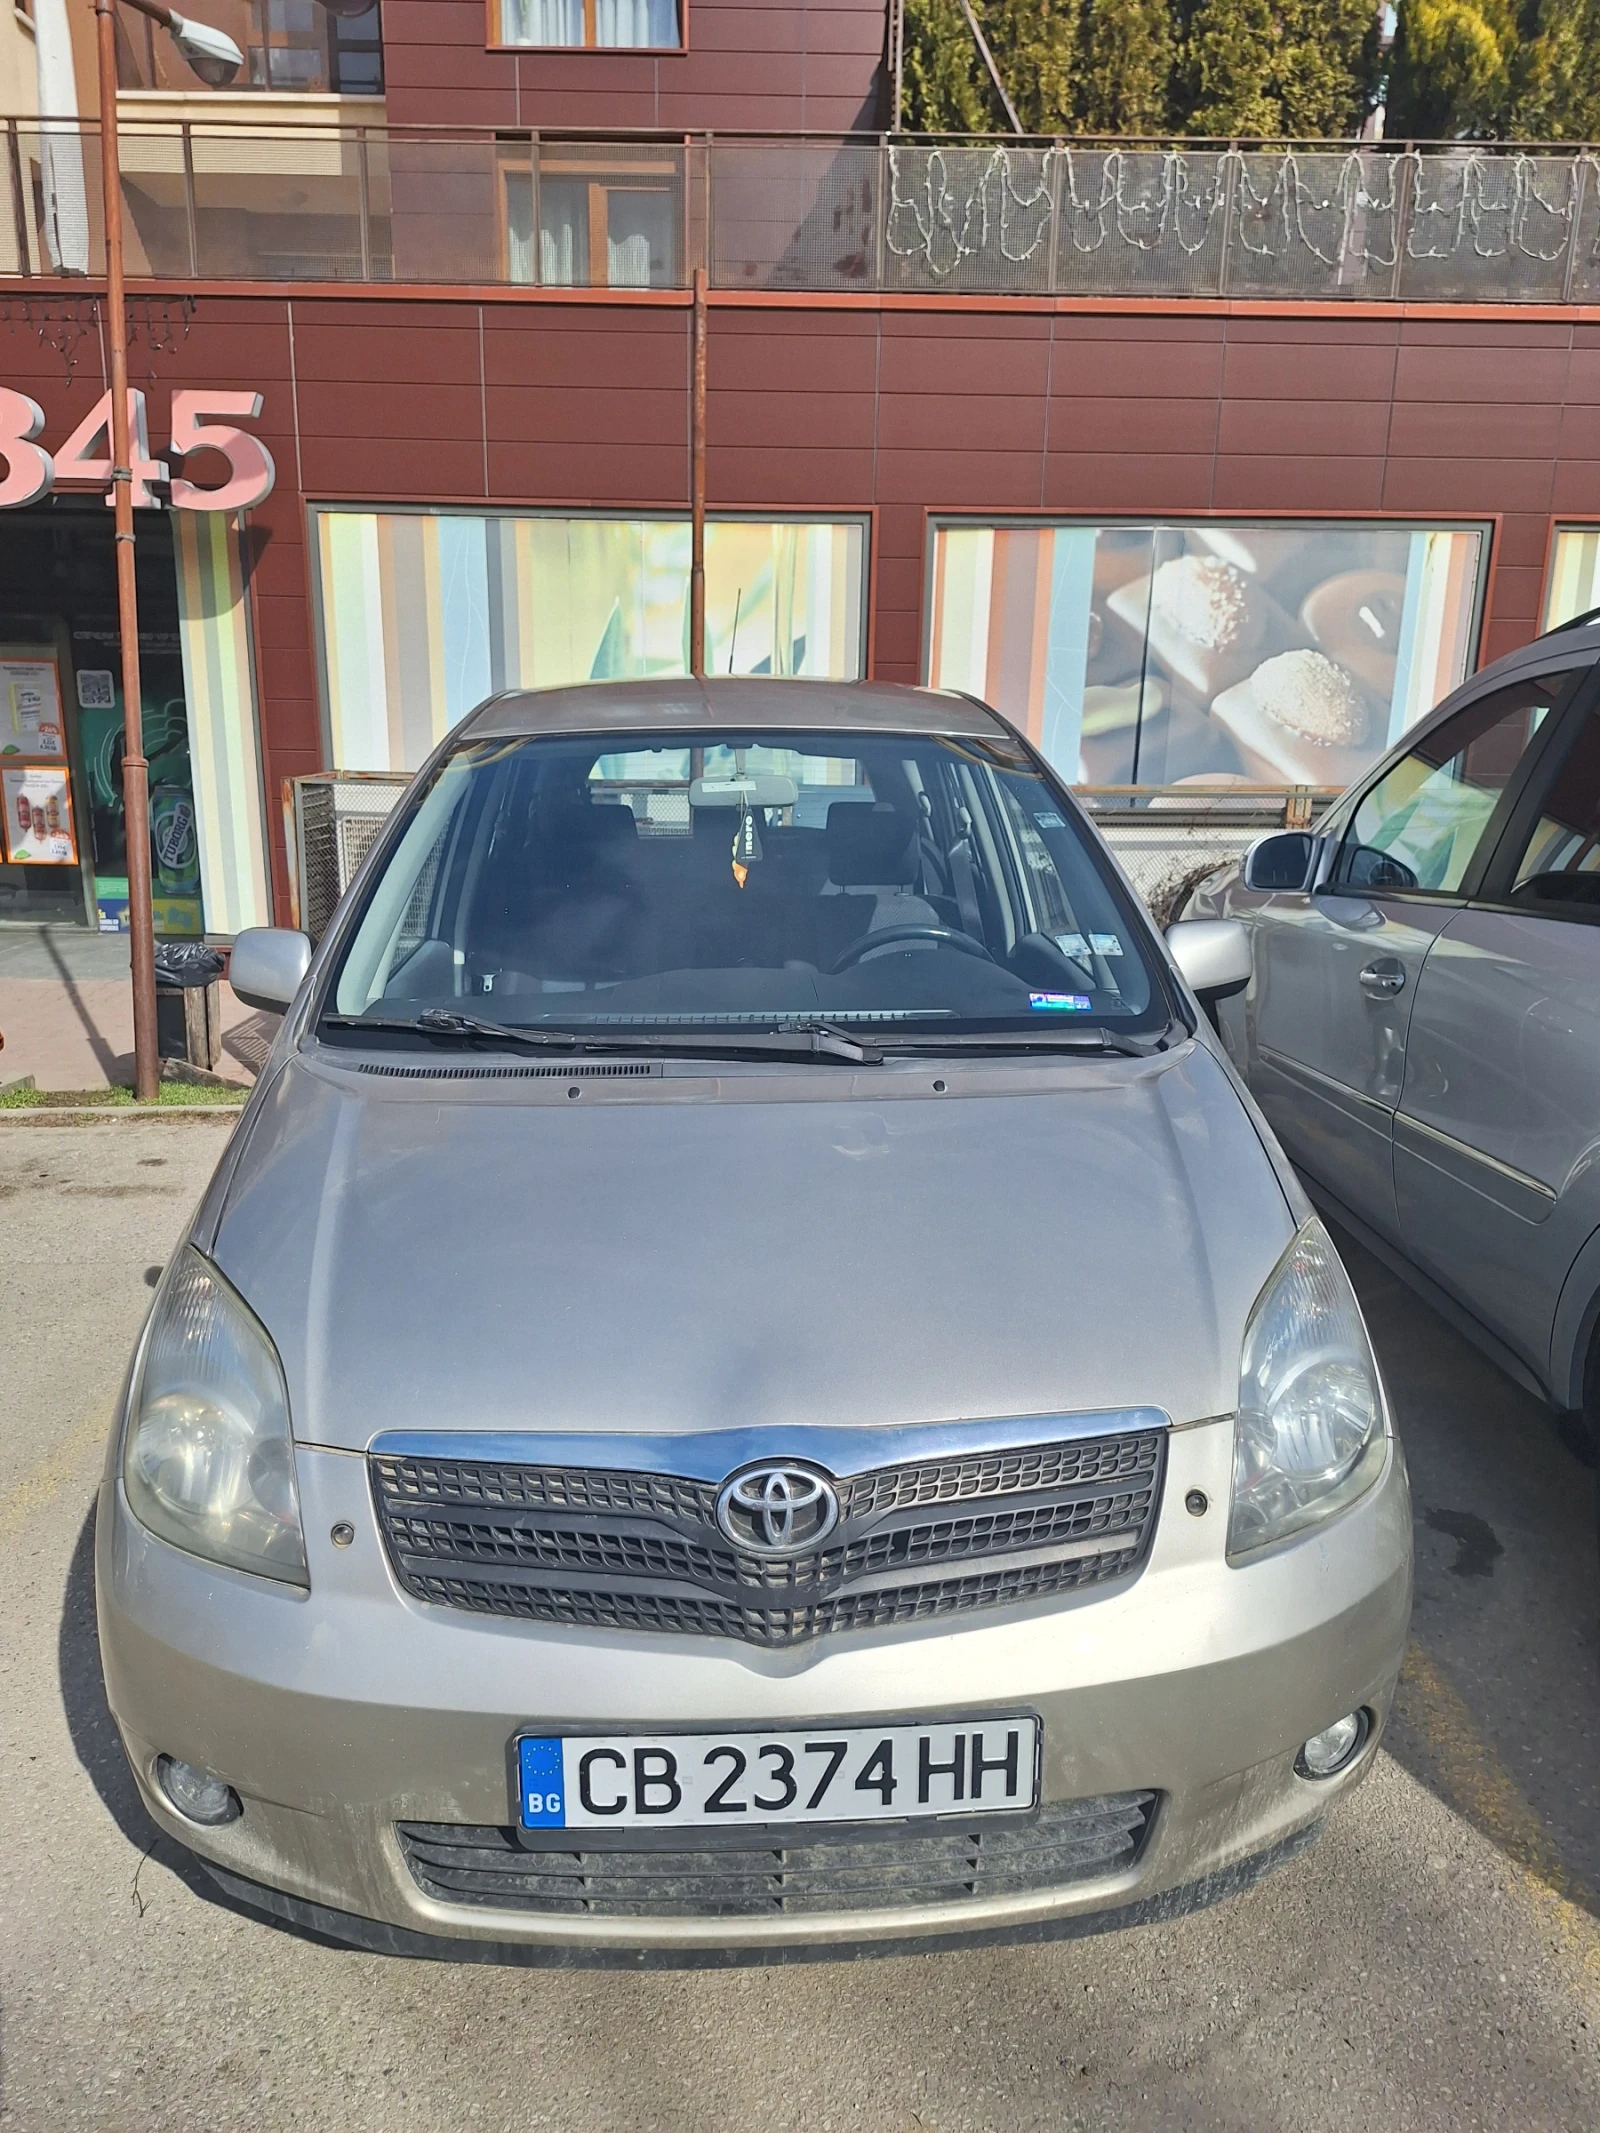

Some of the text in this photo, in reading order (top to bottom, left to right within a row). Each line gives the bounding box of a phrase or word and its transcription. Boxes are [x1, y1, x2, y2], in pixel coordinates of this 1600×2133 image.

[163, 816, 189, 862] TUBORG
[579, 1730, 1019, 1815] CB 2374 HH
[528, 1793, 561, 1813] BG
